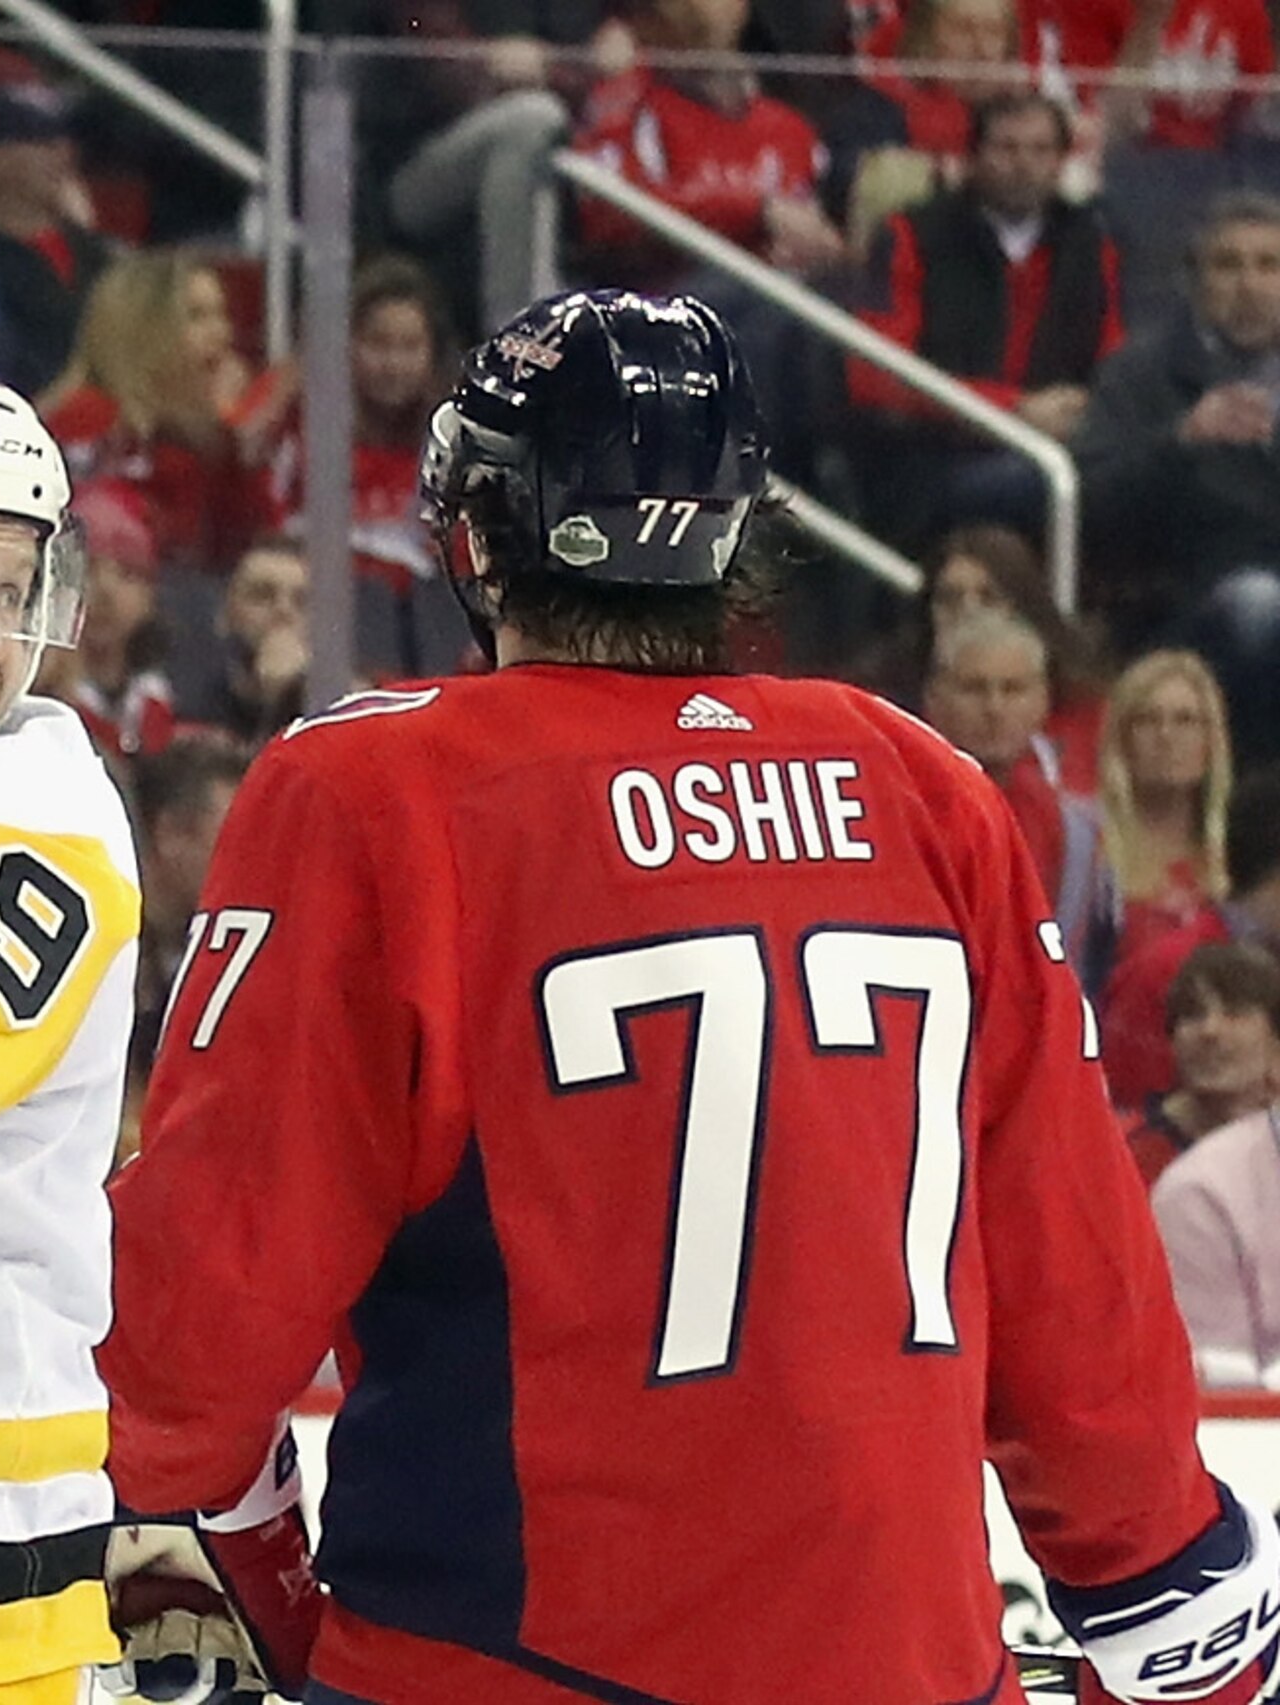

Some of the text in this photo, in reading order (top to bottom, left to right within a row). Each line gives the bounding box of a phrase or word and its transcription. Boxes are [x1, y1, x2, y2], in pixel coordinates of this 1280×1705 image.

[636, 497, 700, 548] 77
[676, 713, 754, 732] adidas
[608, 758, 874, 870] OSHIE
[534, 922, 976, 1388] 77
